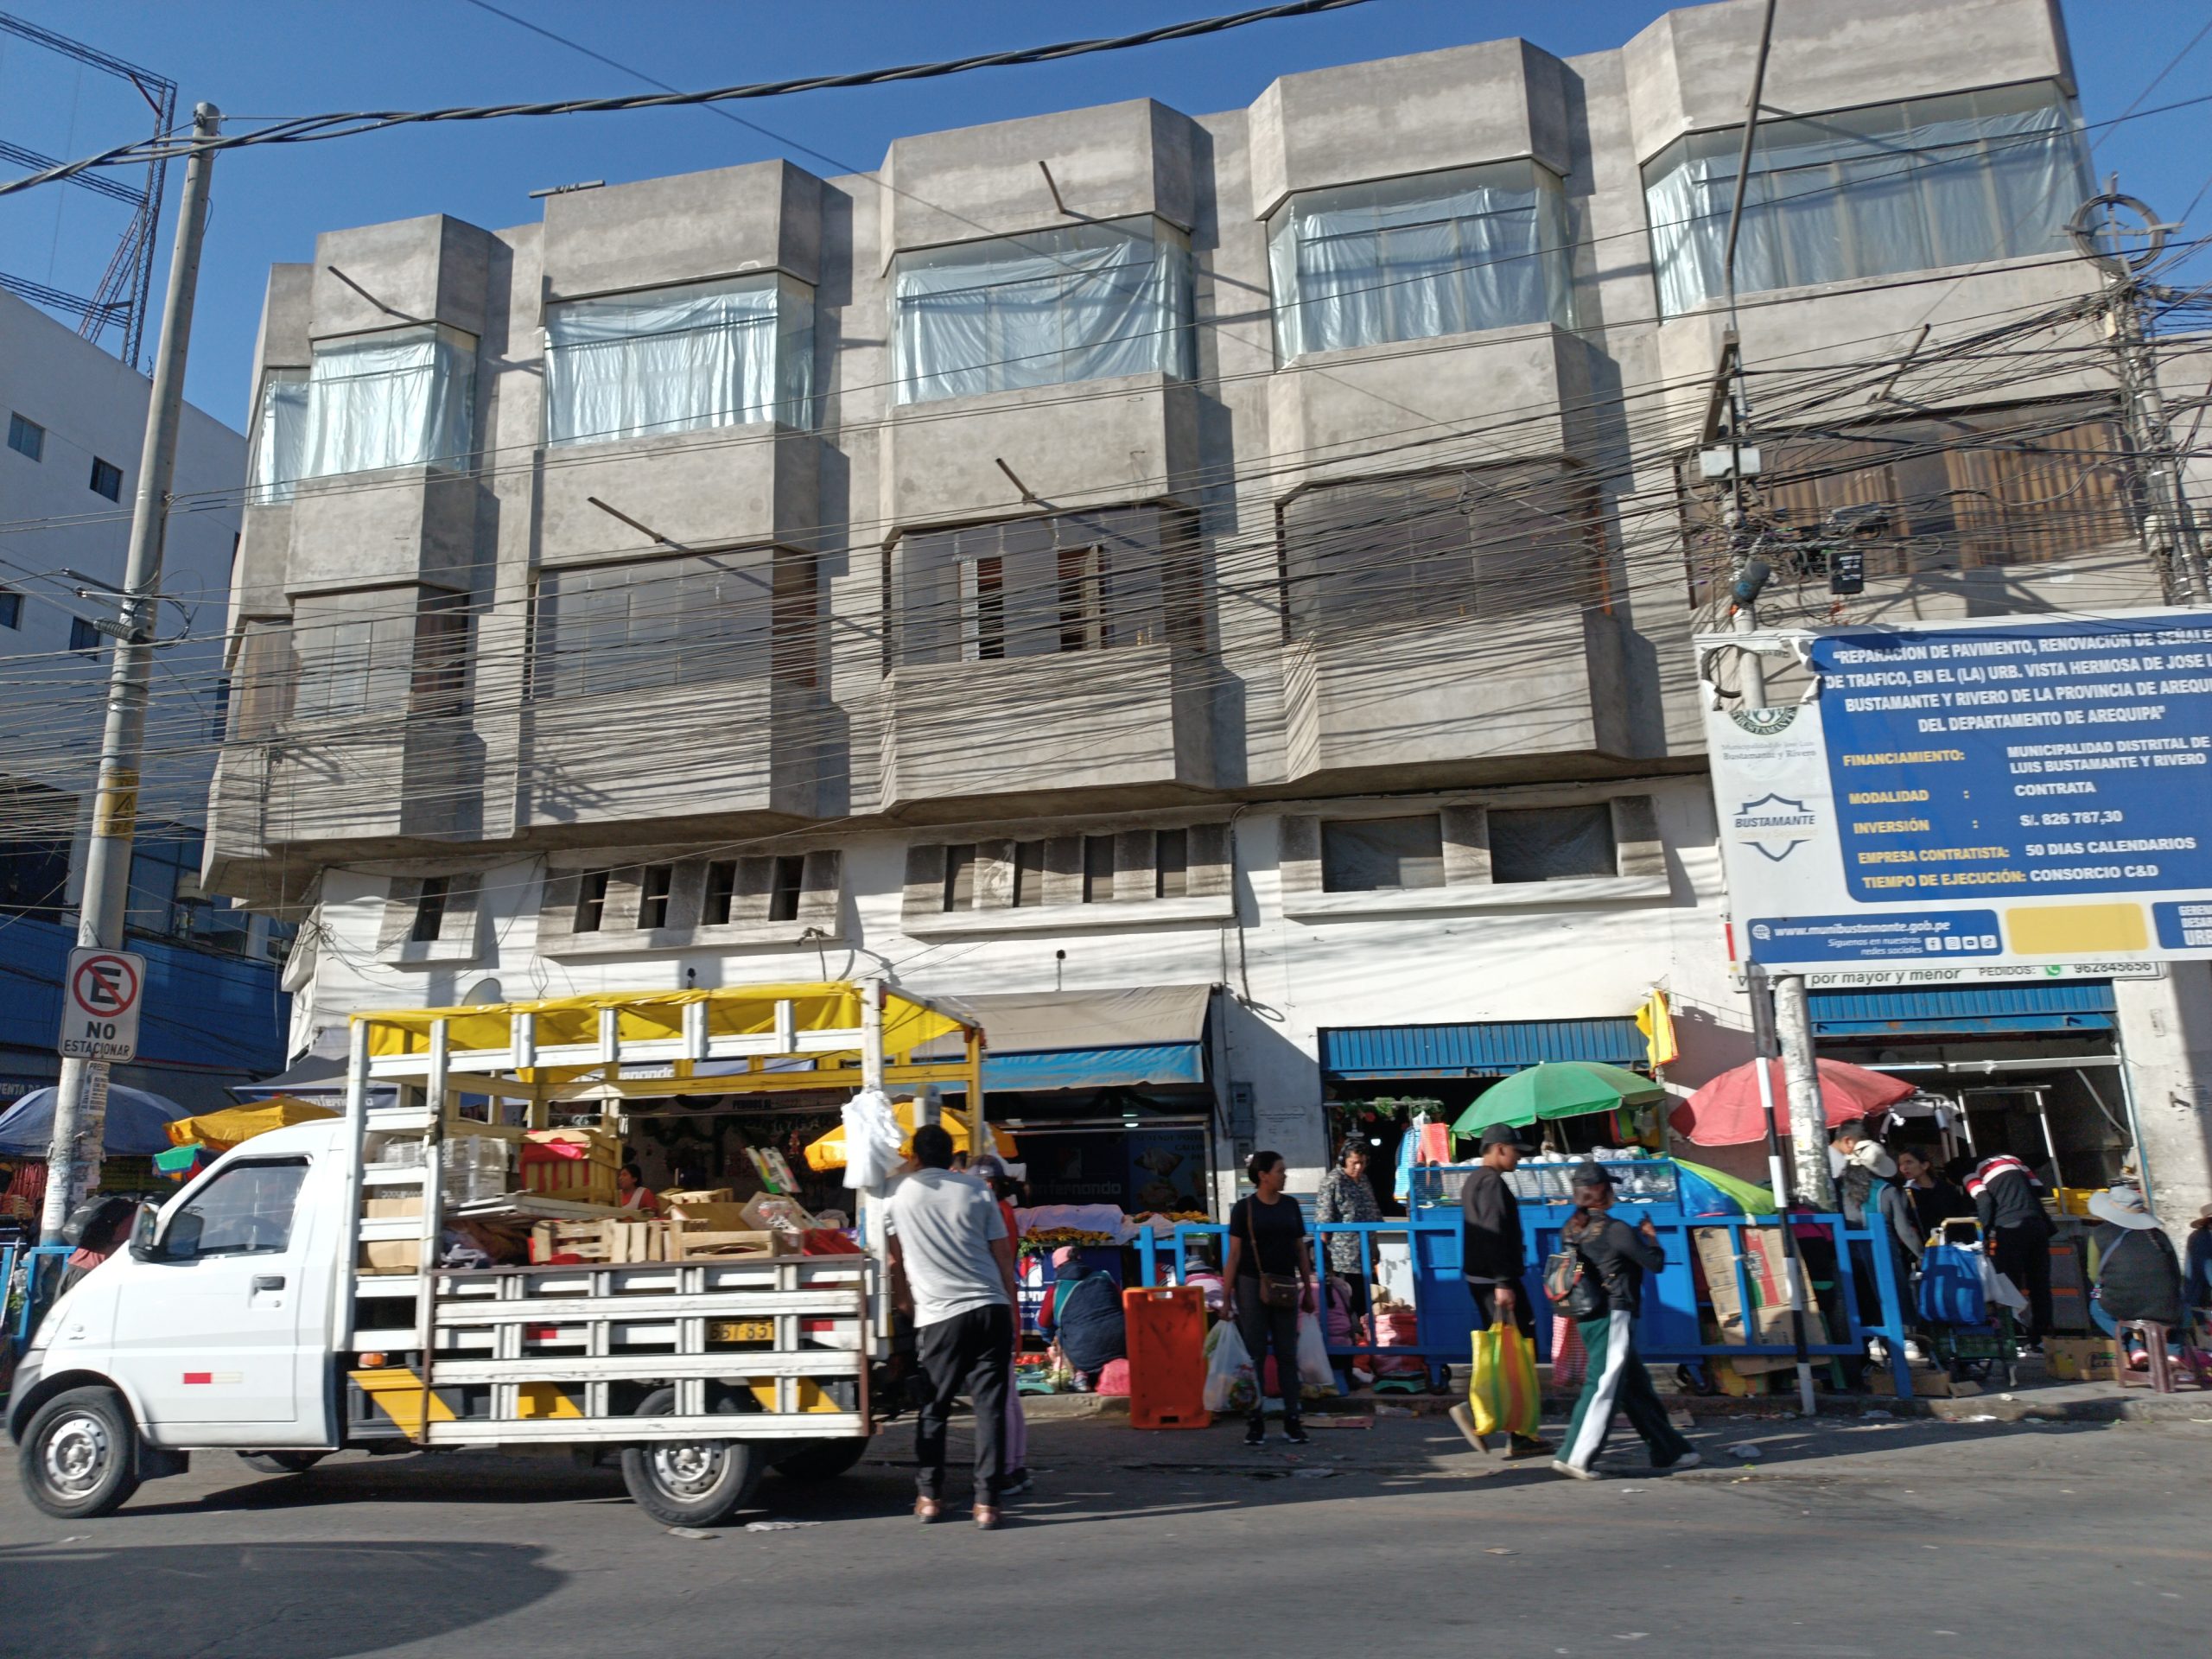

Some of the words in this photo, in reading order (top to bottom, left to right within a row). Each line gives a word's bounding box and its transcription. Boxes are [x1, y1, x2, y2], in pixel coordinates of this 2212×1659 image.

[1930, 645, 1949, 659] DE
[1952, 640, 2037, 658] PAVIMENTO,
[2135, 632, 2154, 646] DE
[1825, 675, 1844, 689] DE
[1846, 671, 1912, 688] TRAFICO,
[1914, 669, 1933, 684] EN
[1936, 669, 1955, 683] EL
[1957, 666, 1986, 685] (LA)
[1986, 664, 2023, 680] URB.
[2024, 662, 2068, 677] VISTA
[2069, 658, 2140, 674] HERMOSA
[2142, 657, 2163, 671] DE
[2166, 654, 2205, 670] JOSE
[1845, 693, 1940, 712] BUSTAMANTE
[1941, 692, 1953, 706] Y
[1955, 690, 2009, 706] RIVERO
[2012, 688, 2031, 703] DE
[2033, 687, 2054, 702] LA
[2055, 683, 2135, 701] PROVINCIA
[2136, 681, 2157, 696] DE
[1917, 718, 1947, 733] DEL
[1948, 711, 2062, 731] DEPARTAMENTO
[2064, 709, 2085, 724] DE
[2006, 741, 2113, 758] MUNICIPALIDAD
[2116, 738, 2189, 752] DISTRITAL
[2190, 736, 2211, 748] DE
[1842, 749, 1966, 766] FINANCIAMIENTO:
[2009, 761, 2043, 774] LUIS
[2044, 756, 2139, 772] BUSTAMANTE
[2139, 756, 2151, 767] Y
[2153, 753, 2207, 767] RIVERO
[1848, 789, 1929, 804] MODALIDAD
[2014, 781, 2097, 796] CONTRATA
[1735, 816, 1815, 828] BUSTAMANTE
[1853, 817, 1930, 834] INVERSIÓN
[2041, 812, 2070, 825] 826
[2071, 810, 2123, 825] 787,30
[1858, 850, 1917, 864] EMPRESA
[1918, 846, 2010, 861] CONTRATISTA:
[2025, 843, 2044, 856] 50
[2048, 842, 2084, 855] DIAS
[2087, 836, 2196, 854] CALENDARIOS
[1862, 874, 1916, 888] TIEMPO
[1918, 874, 1939, 887] DE
[1941, 868, 2026, 886] EJECUCIÓN:
[2030, 866, 2121, 881] CONSORCIO
[2124, 864, 2158, 878] C&D
[1860, 947, 1886, 956] redes
[1887, 946, 1923, 955] sociales
[1811, 974, 1839, 987] por
[1842, 971, 1891, 985] mayor
[1892, 971, 1904, 984] y
[1910, 969, 1961, 981] menor
[1979, 964, 2036, 976] PEDIDOS:
[90, 965, 121, 1005] E
[86, 1020, 116, 1040] NO
[64, 1039, 130, 1057] ESTACIONAR
